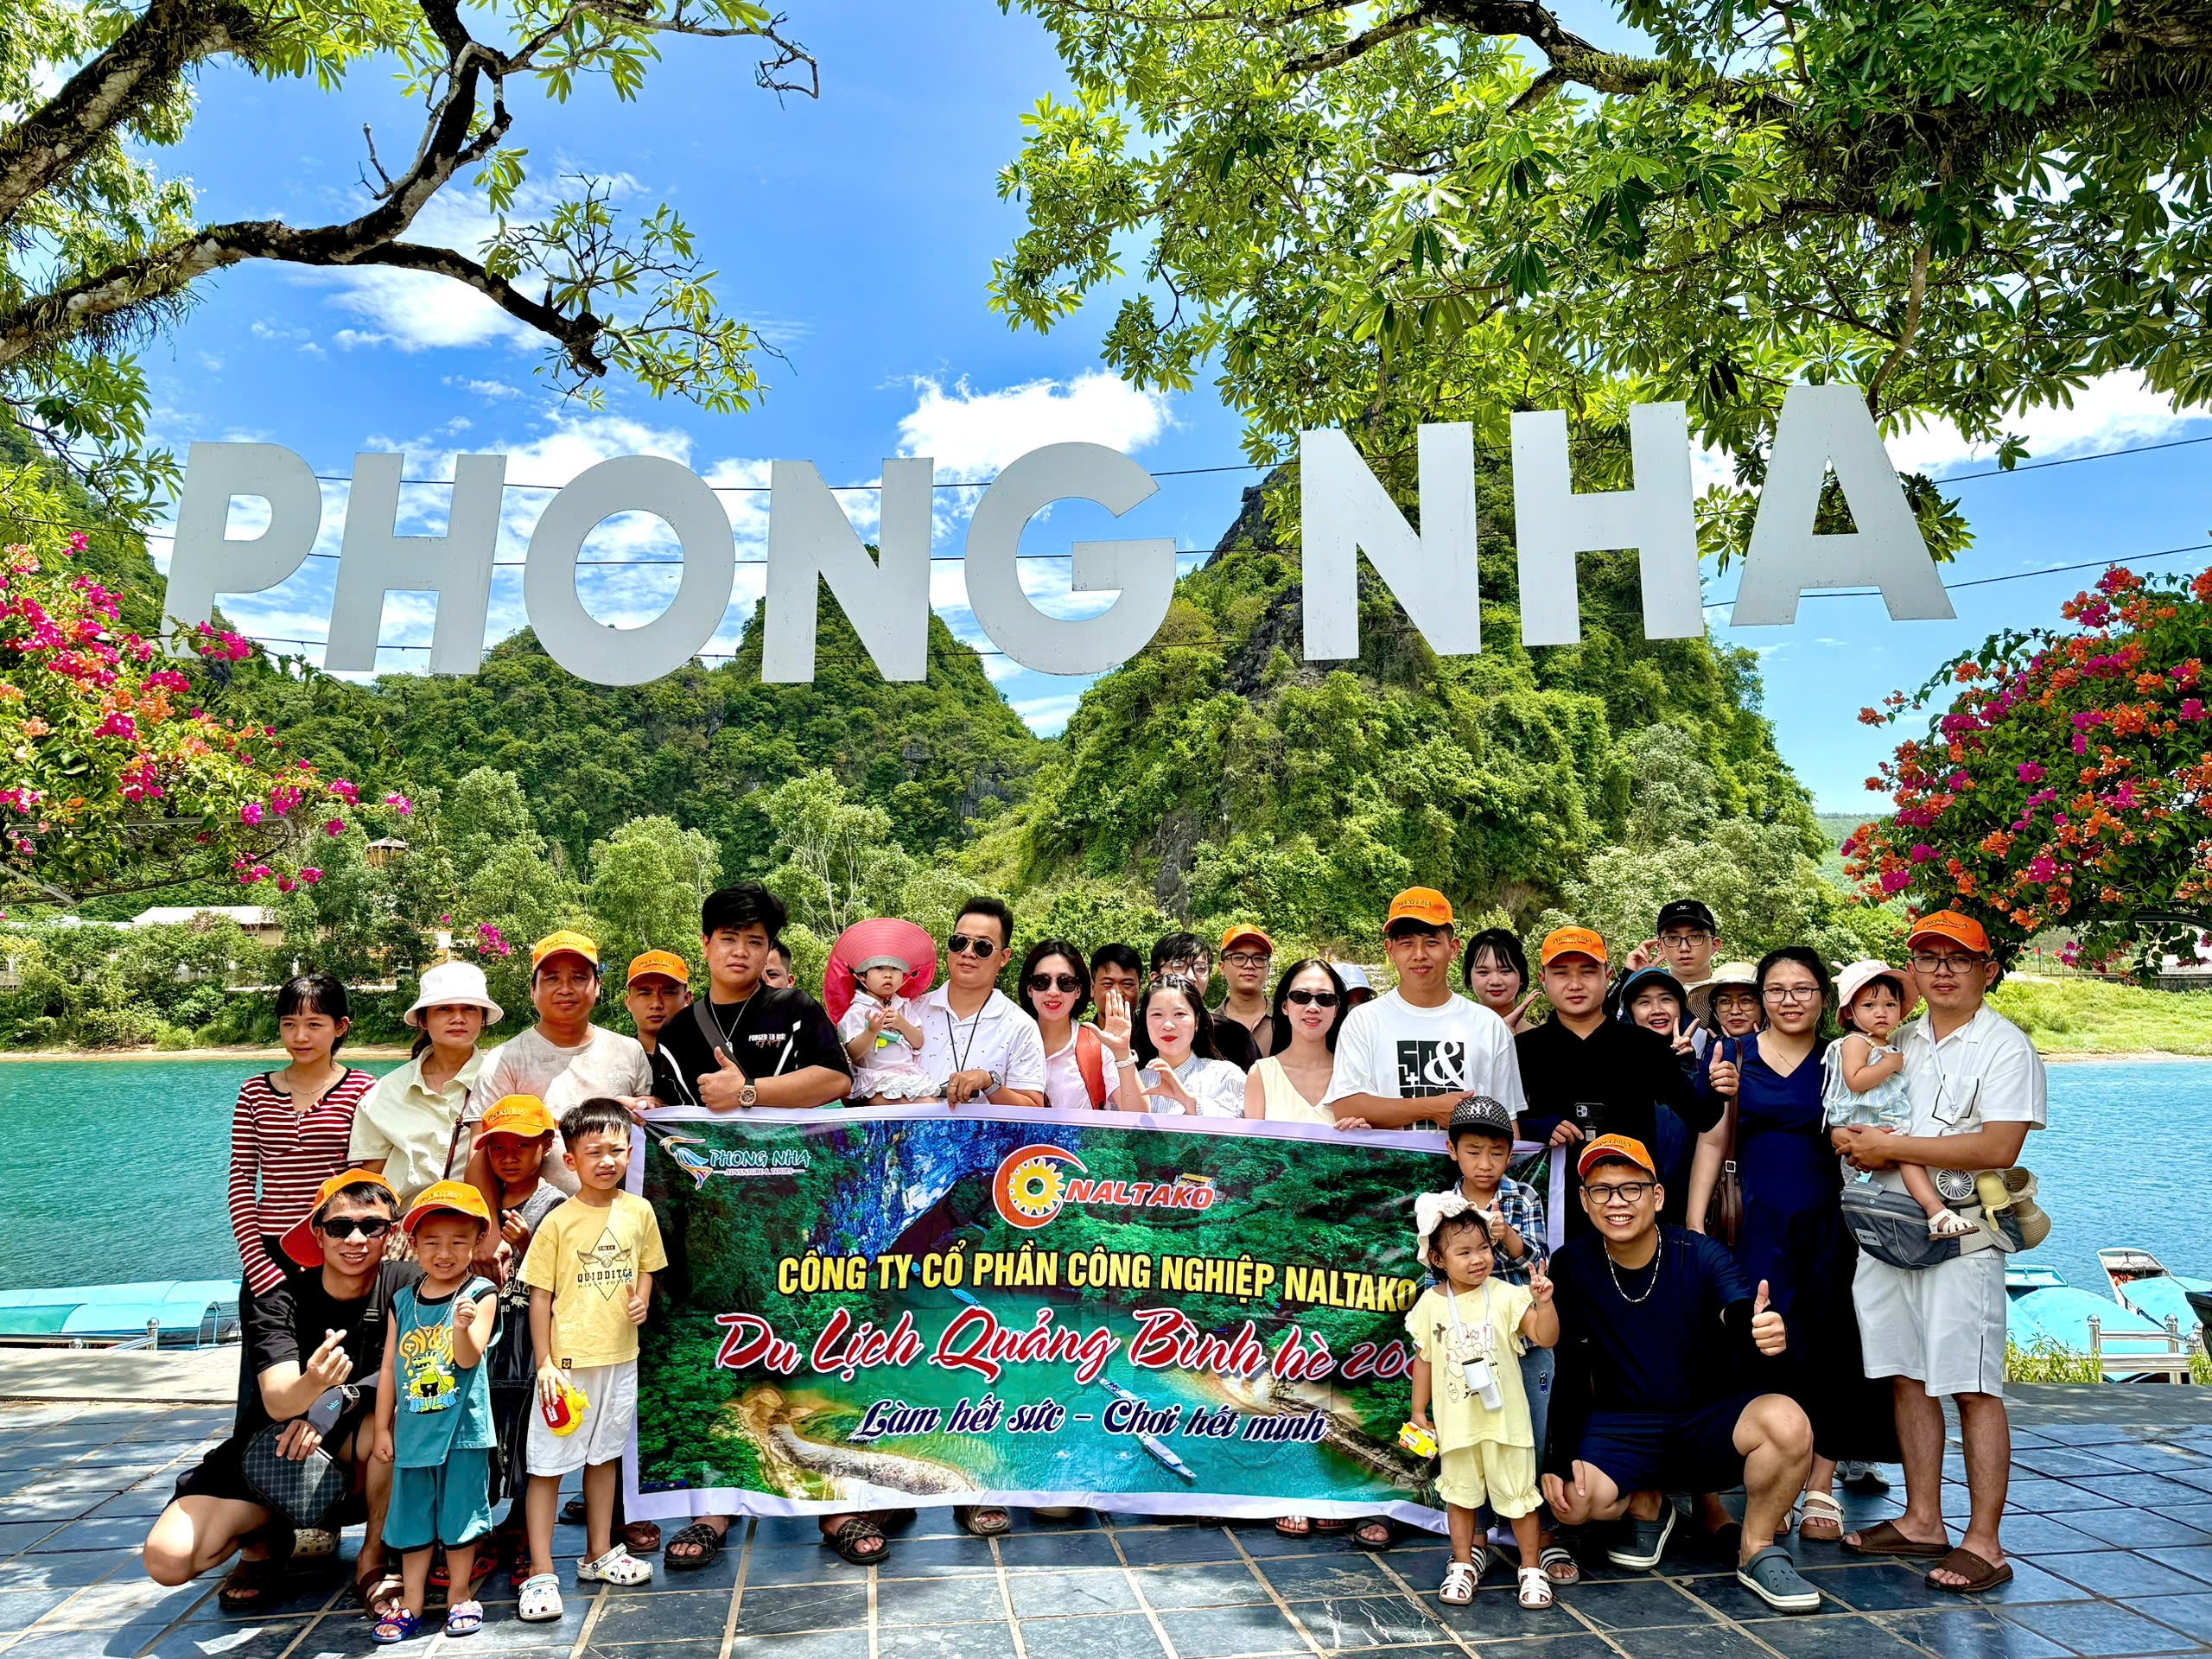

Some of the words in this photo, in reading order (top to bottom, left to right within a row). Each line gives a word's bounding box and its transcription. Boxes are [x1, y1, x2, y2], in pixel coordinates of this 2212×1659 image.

[161, 442, 1177, 685] PHONG
[1300, 385, 1957, 660] NHA
[1470, 1103, 1492, 1116] NY
[709, 1149, 768, 1167] PHONG
[772, 1149, 811, 1167] NHA
[1064, 1179, 1216, 1210] NALTAKO
[779, 1250, 867, 1294] CÔNG
[877, 1254, 912, 1289] TY
[922, 1239, 966, 1287] CỔ
[974, 1240, 1058, 1287] PHẦN
[1067, 1245, 1151, 1289] CÔNG
[1161, 1255, 1275, 1303] NGHIỆP
[1285, 1267, 1416, 1312] NALTAKO
[715, 1313, 802, 1374] Du
[810, 1306, 925, 1382] Lịch
[928, 1305, 1122, 1384] Quảng
[1128, 1308, 1267, 1377] Bình
[1271, 1325, 1337, 1380] hè
[855, 1399, 942, 1437] Làm
[944, 1392, 1003, 1434] hết
[1006, 1396, 1065, 1433] sức
[1103, 1399, 1183, 1435] Chơi
[1183, 1404, 1239, 1439] hết
[1241, 1408, 1329, 1442] mình
